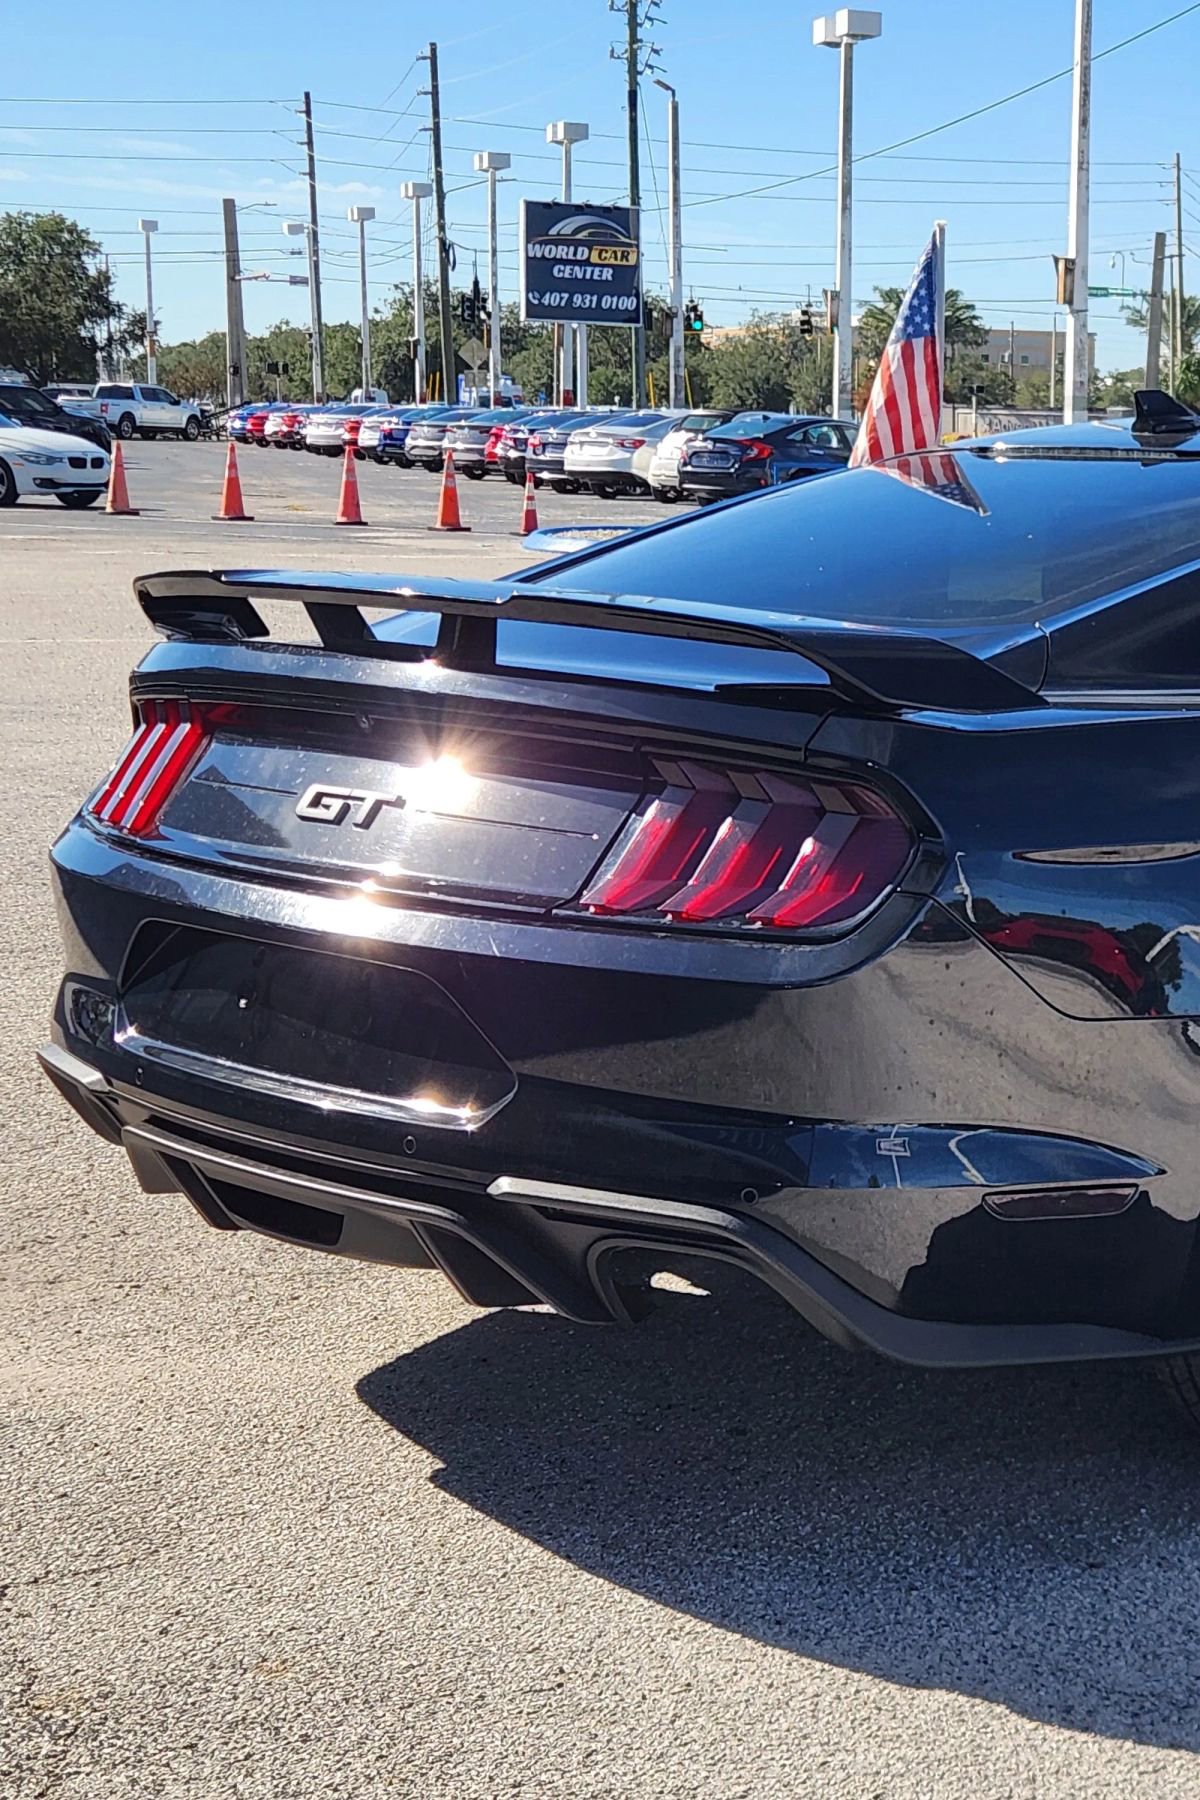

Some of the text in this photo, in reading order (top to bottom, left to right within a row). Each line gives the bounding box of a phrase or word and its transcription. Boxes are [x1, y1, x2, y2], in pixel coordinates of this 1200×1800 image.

[527, 243, 630, 262] WORLD CAR
[553, 264, 613, 281] CENTER
[541, 292, 637, 311] 407 931 0100
[296, 783, 407, 831] GT
